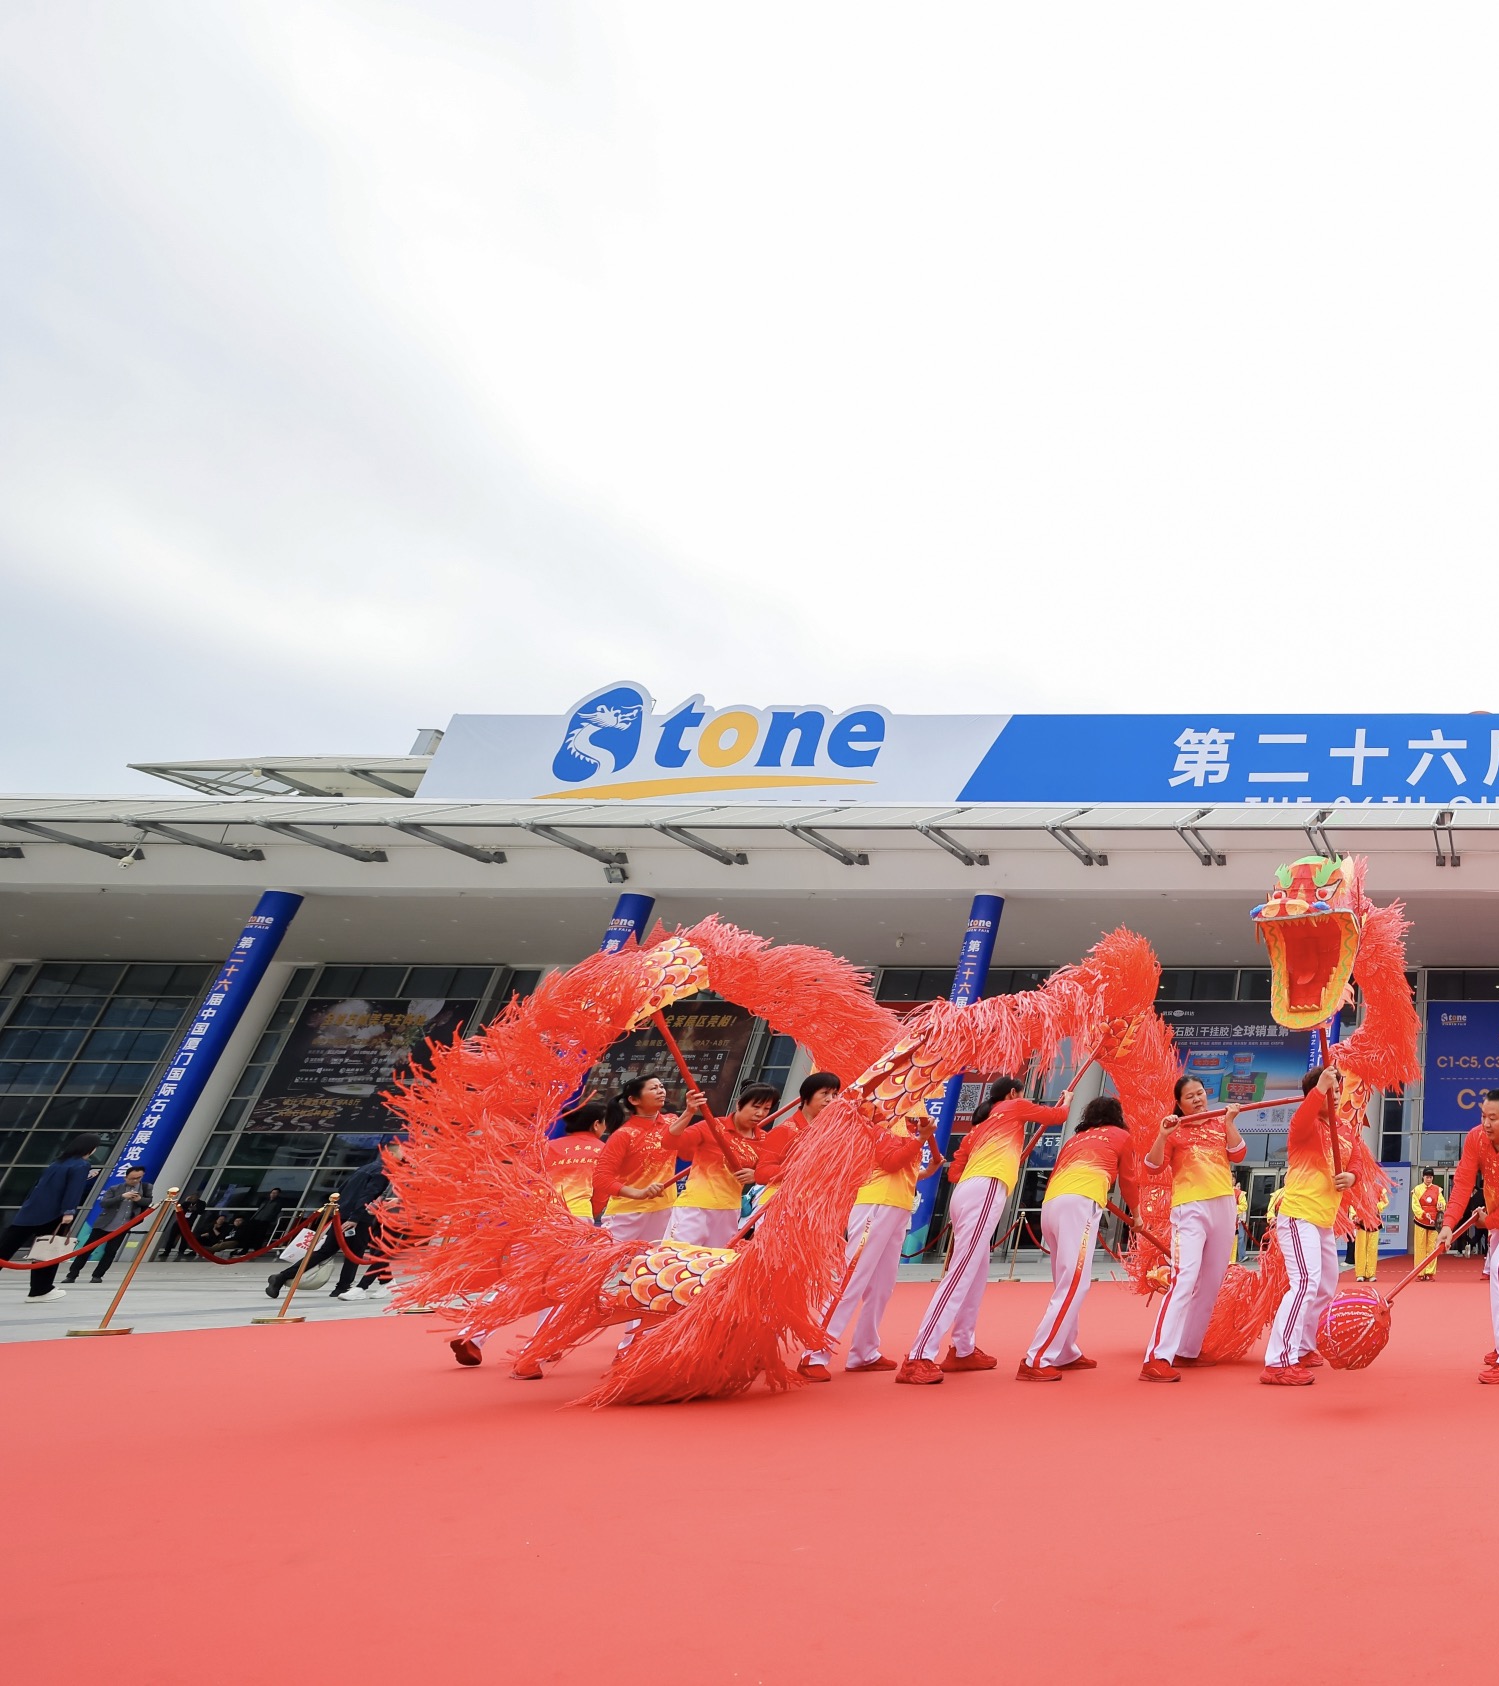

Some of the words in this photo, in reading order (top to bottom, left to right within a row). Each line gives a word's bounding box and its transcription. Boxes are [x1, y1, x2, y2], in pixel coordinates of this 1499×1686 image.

[115, 936, 257, 1178] 第二十六届中国厦门国际石材展览会
